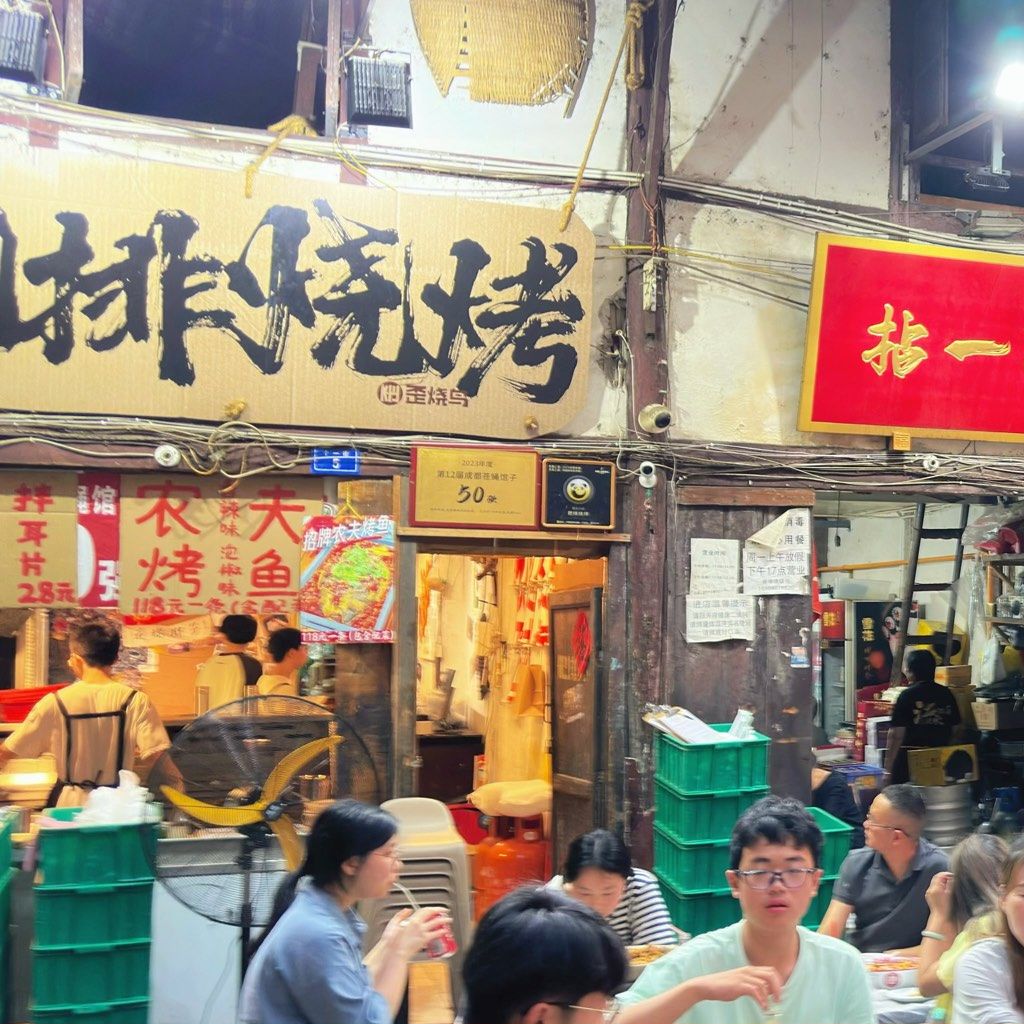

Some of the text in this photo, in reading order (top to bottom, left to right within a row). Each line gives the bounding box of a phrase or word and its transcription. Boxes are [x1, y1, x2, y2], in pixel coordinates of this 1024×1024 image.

[461, 460, 493, 468] 2023年度
[437, 470, 518, 482] 第12届成都苍蝇馆子
[303, 515, 390, 551] 招牌农夫烤鱼
[746, 552, 805, 562] 周一上午放假
[746, 566, 806, 577] 下午17点营业
[17, 581, 78, 604] 28元
